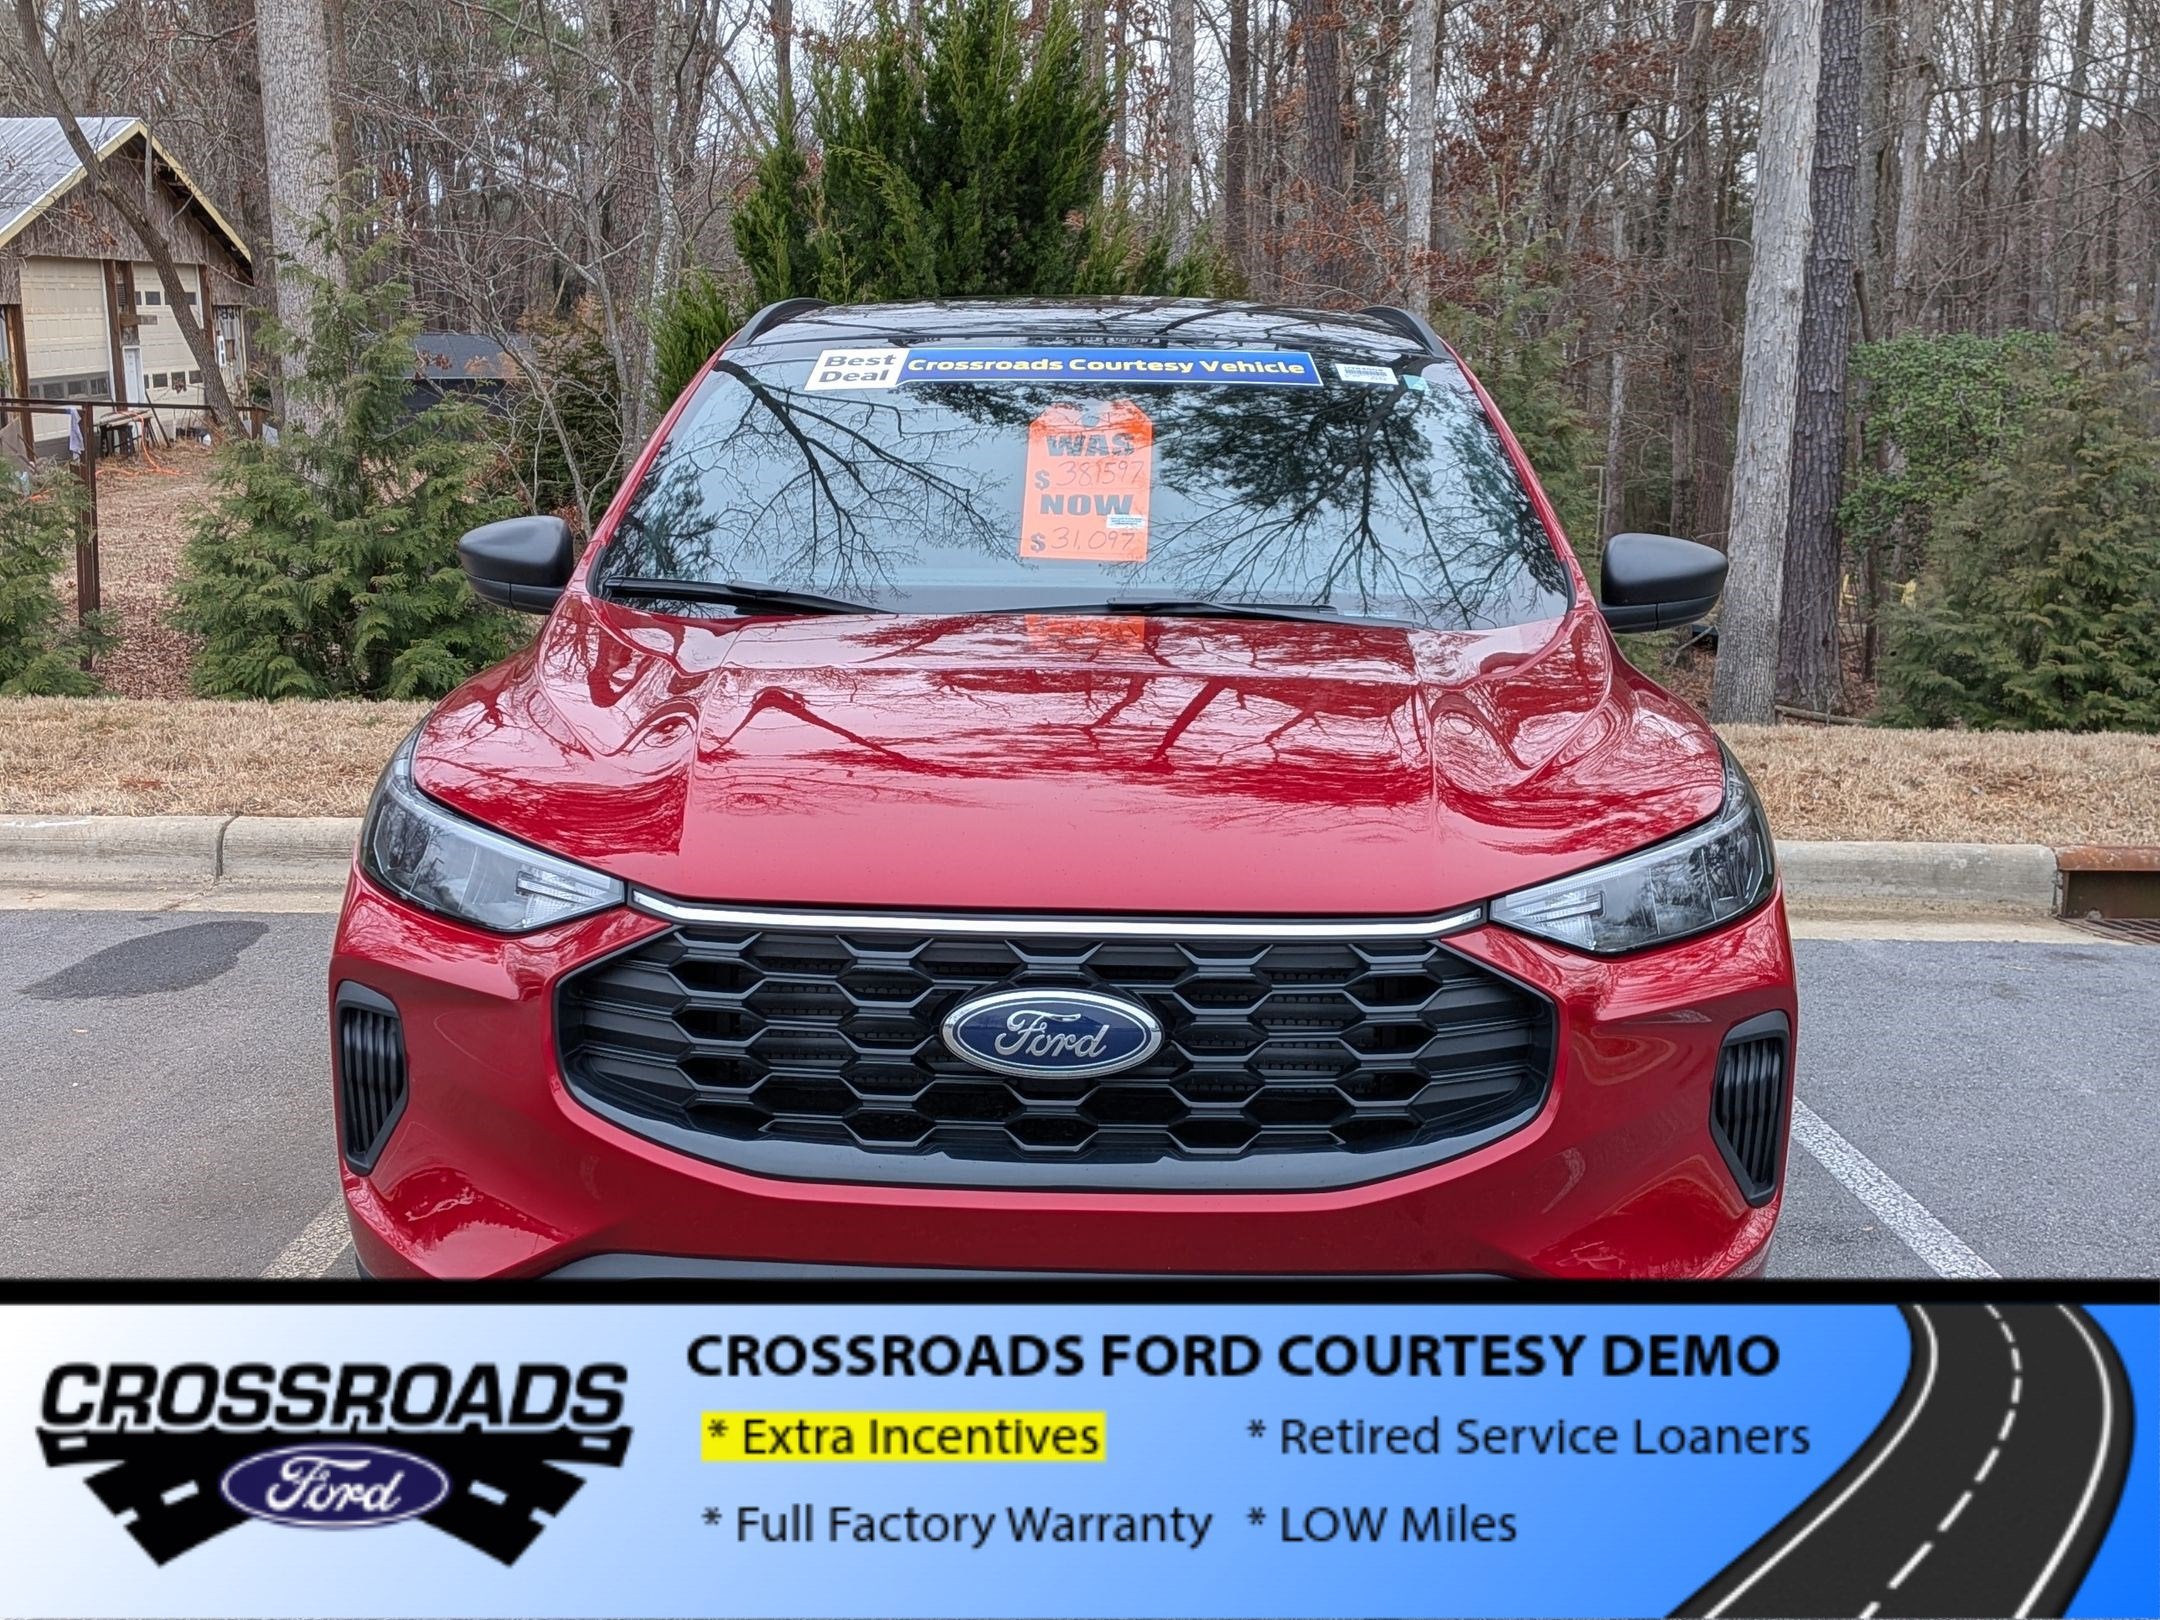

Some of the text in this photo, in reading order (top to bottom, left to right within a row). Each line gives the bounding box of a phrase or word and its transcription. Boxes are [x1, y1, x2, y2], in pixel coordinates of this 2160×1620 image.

[824, 353, 897, 367] Best
[907, 358, 1305, 374] Crossroads Courtesy Vehicle
[818, 369, 890, 383] Deal
[1046, 432, 1135, 457] WAS
[1040, 494, 1134, 516] NOW
[994, 1009, 1110, 1058] Ford
